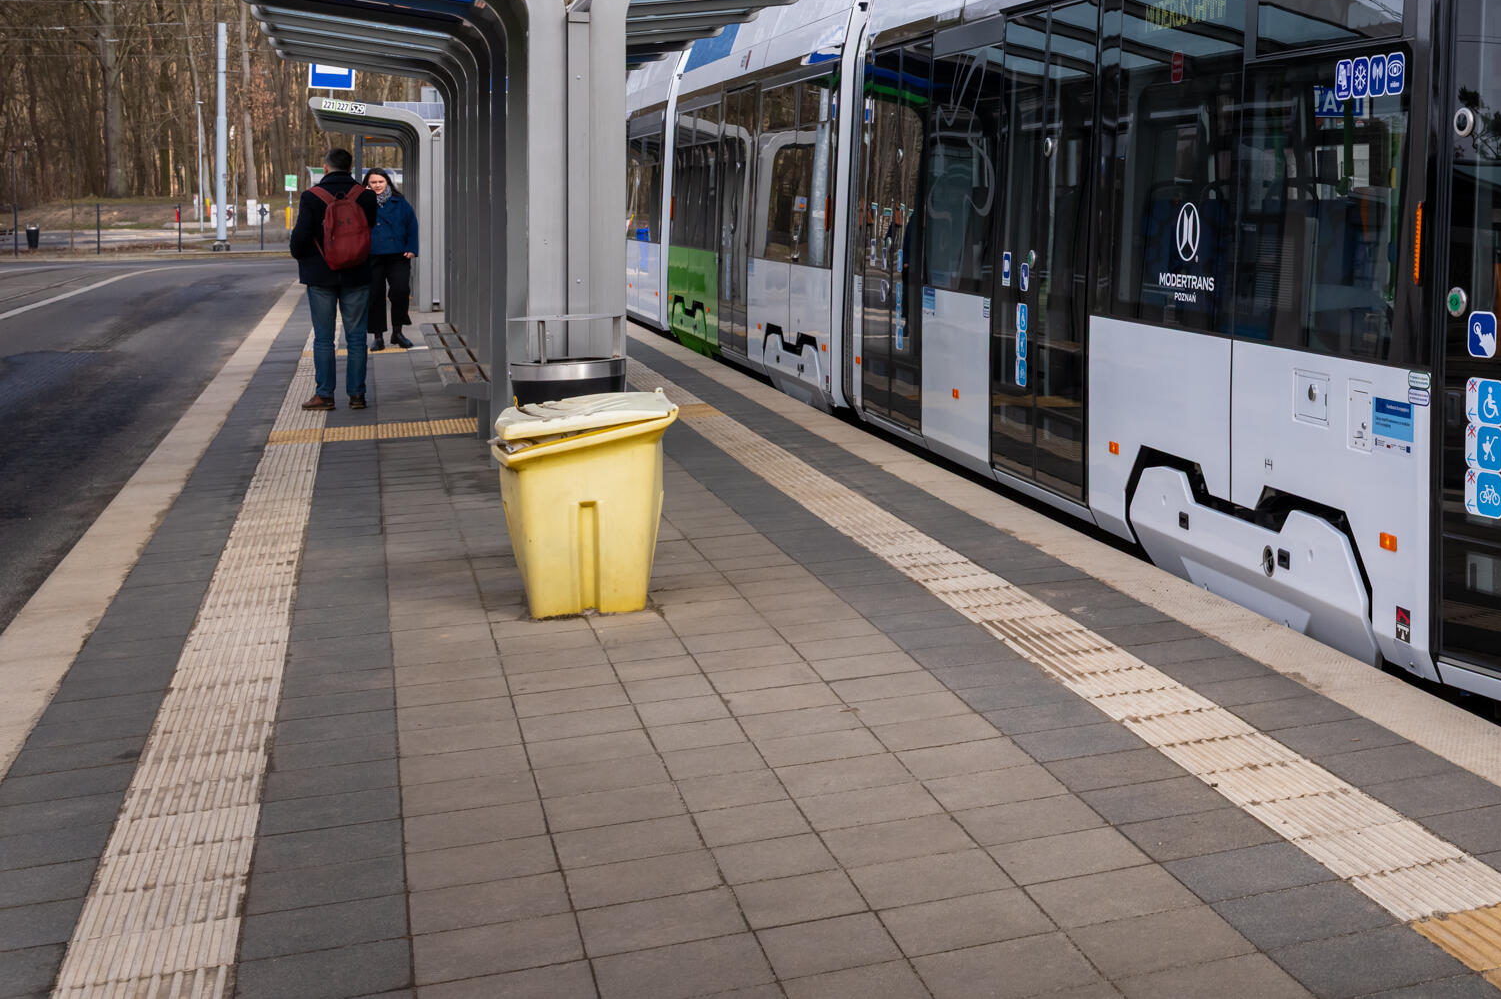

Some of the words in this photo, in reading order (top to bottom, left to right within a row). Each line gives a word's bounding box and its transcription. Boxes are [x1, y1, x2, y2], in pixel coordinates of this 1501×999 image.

[323, 100, 335, 109] 221
[336, 103, 349, 111] 227
[351, 104, 365, 114] 529
[1314, 90, 1360, 113] TAI
[1159, 272, 1215, 292] MODERTRANS
[1174, 292, 1197, 303] POZNAŃ
